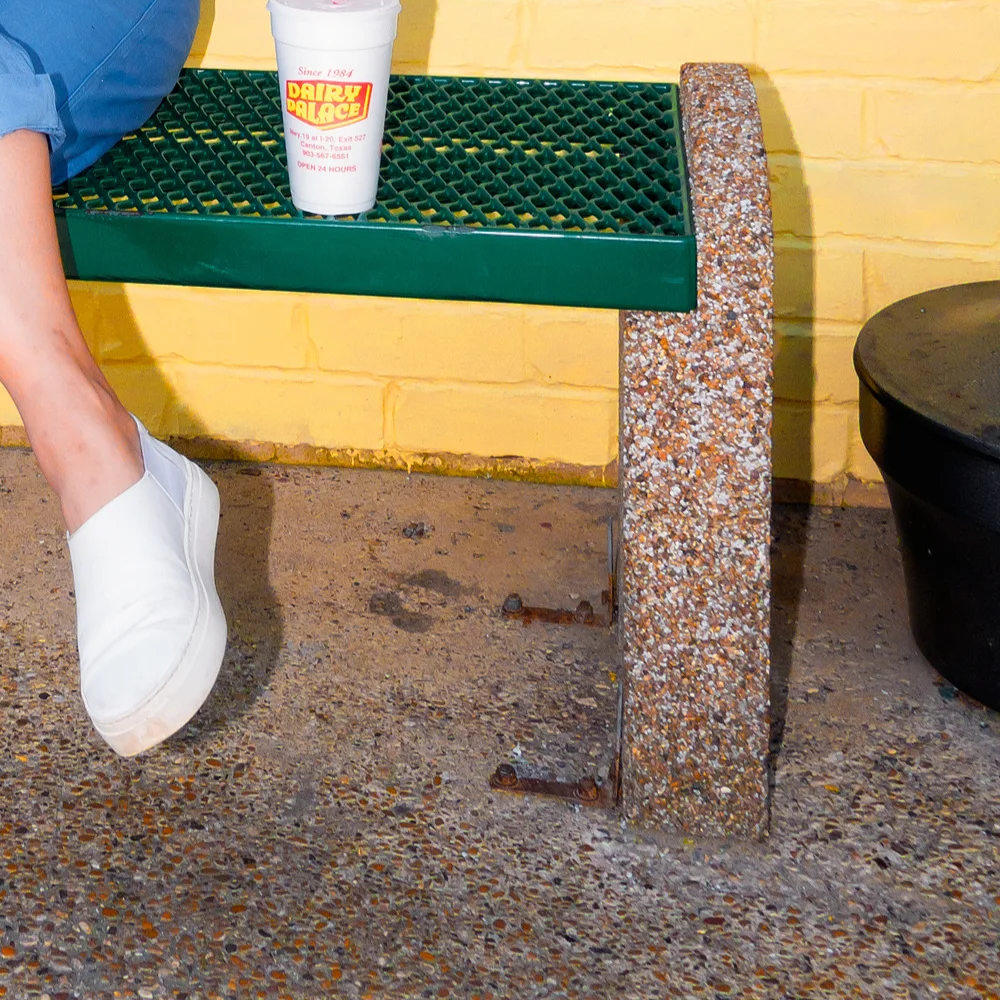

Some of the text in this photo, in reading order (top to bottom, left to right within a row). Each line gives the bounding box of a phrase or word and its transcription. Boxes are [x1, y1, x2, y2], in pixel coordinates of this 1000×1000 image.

[297, 67, 354, 78] Since 1984
[287, 82, 362, 103] DAIRY
[286, 98, 361, 125] PALACE
[329, 144, 352, 152] Texas
[297, 161, 316, 171] OPEN
[328, 165, 357, 173] HOURS
